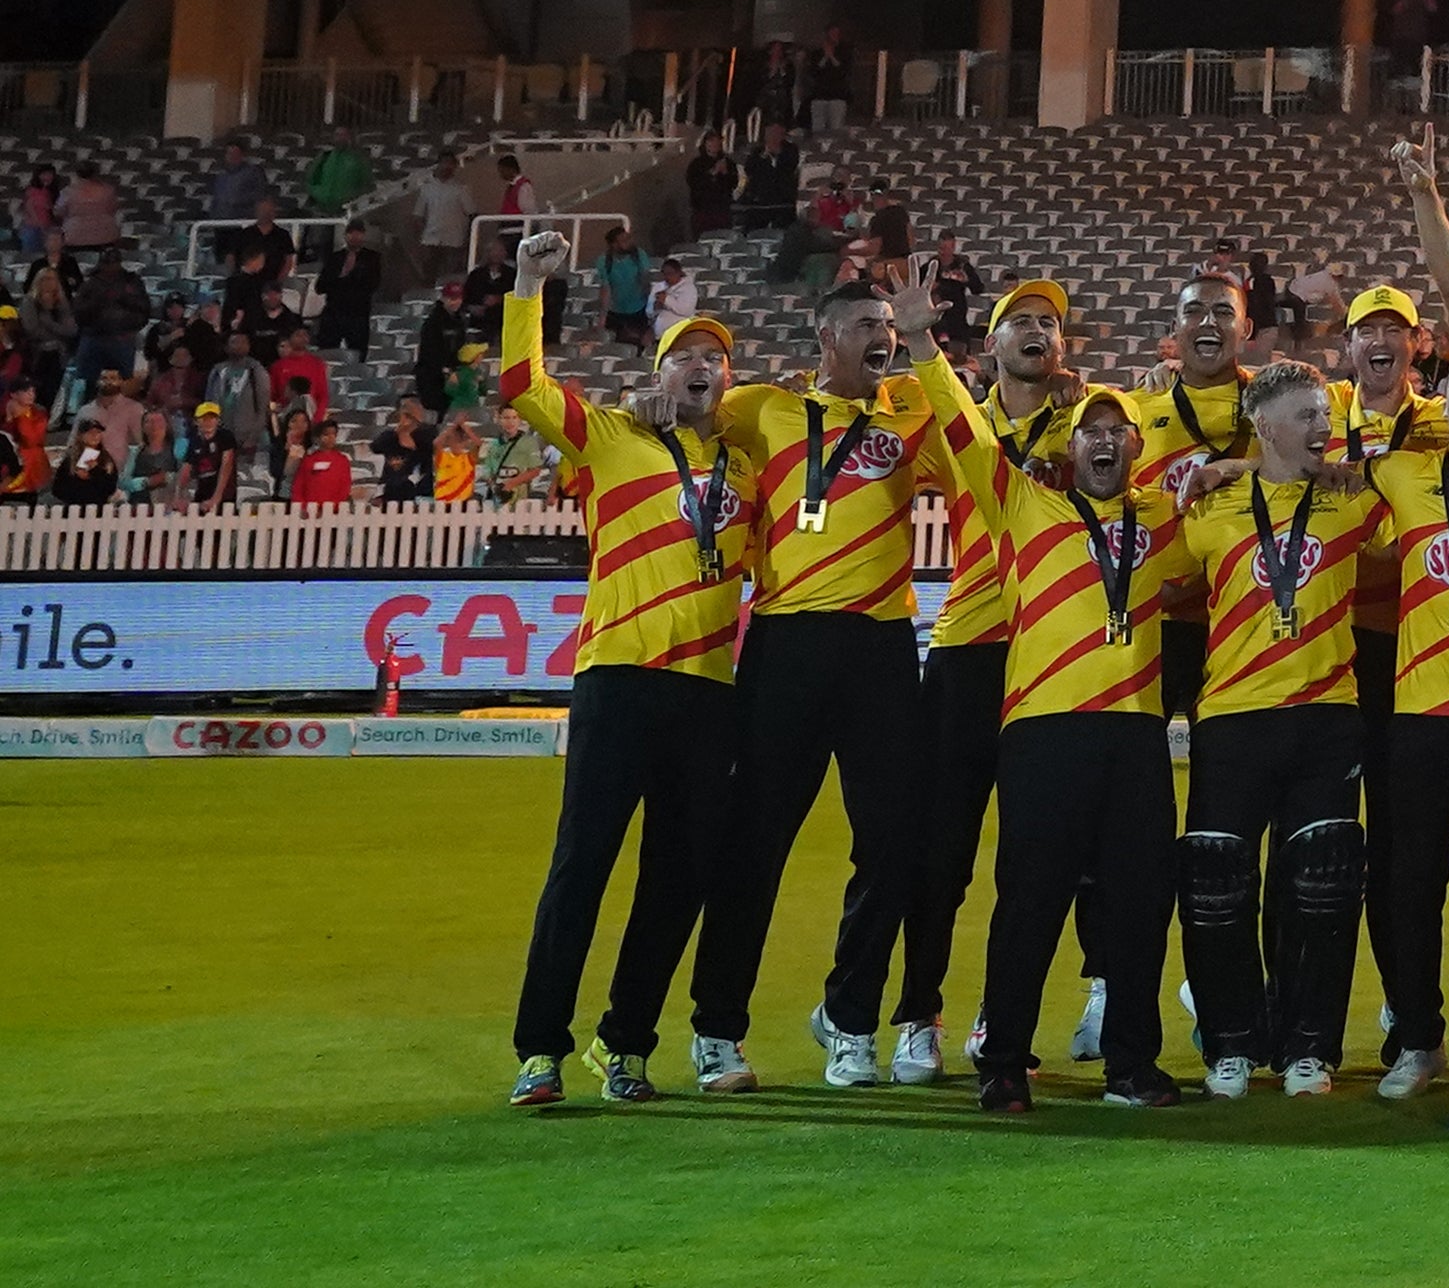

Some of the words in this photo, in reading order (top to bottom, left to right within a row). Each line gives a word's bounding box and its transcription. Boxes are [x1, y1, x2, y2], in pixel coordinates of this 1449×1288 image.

[11, 603, 136, 670] ile.
[363, 593, 587, 677] CAZ
[172, 720, 328, 750] CAZOO
[359, 727, 430, 744] Search.
[434, 727, 486, 745] Drive.
[490, 727, 547, 745] Smile.
